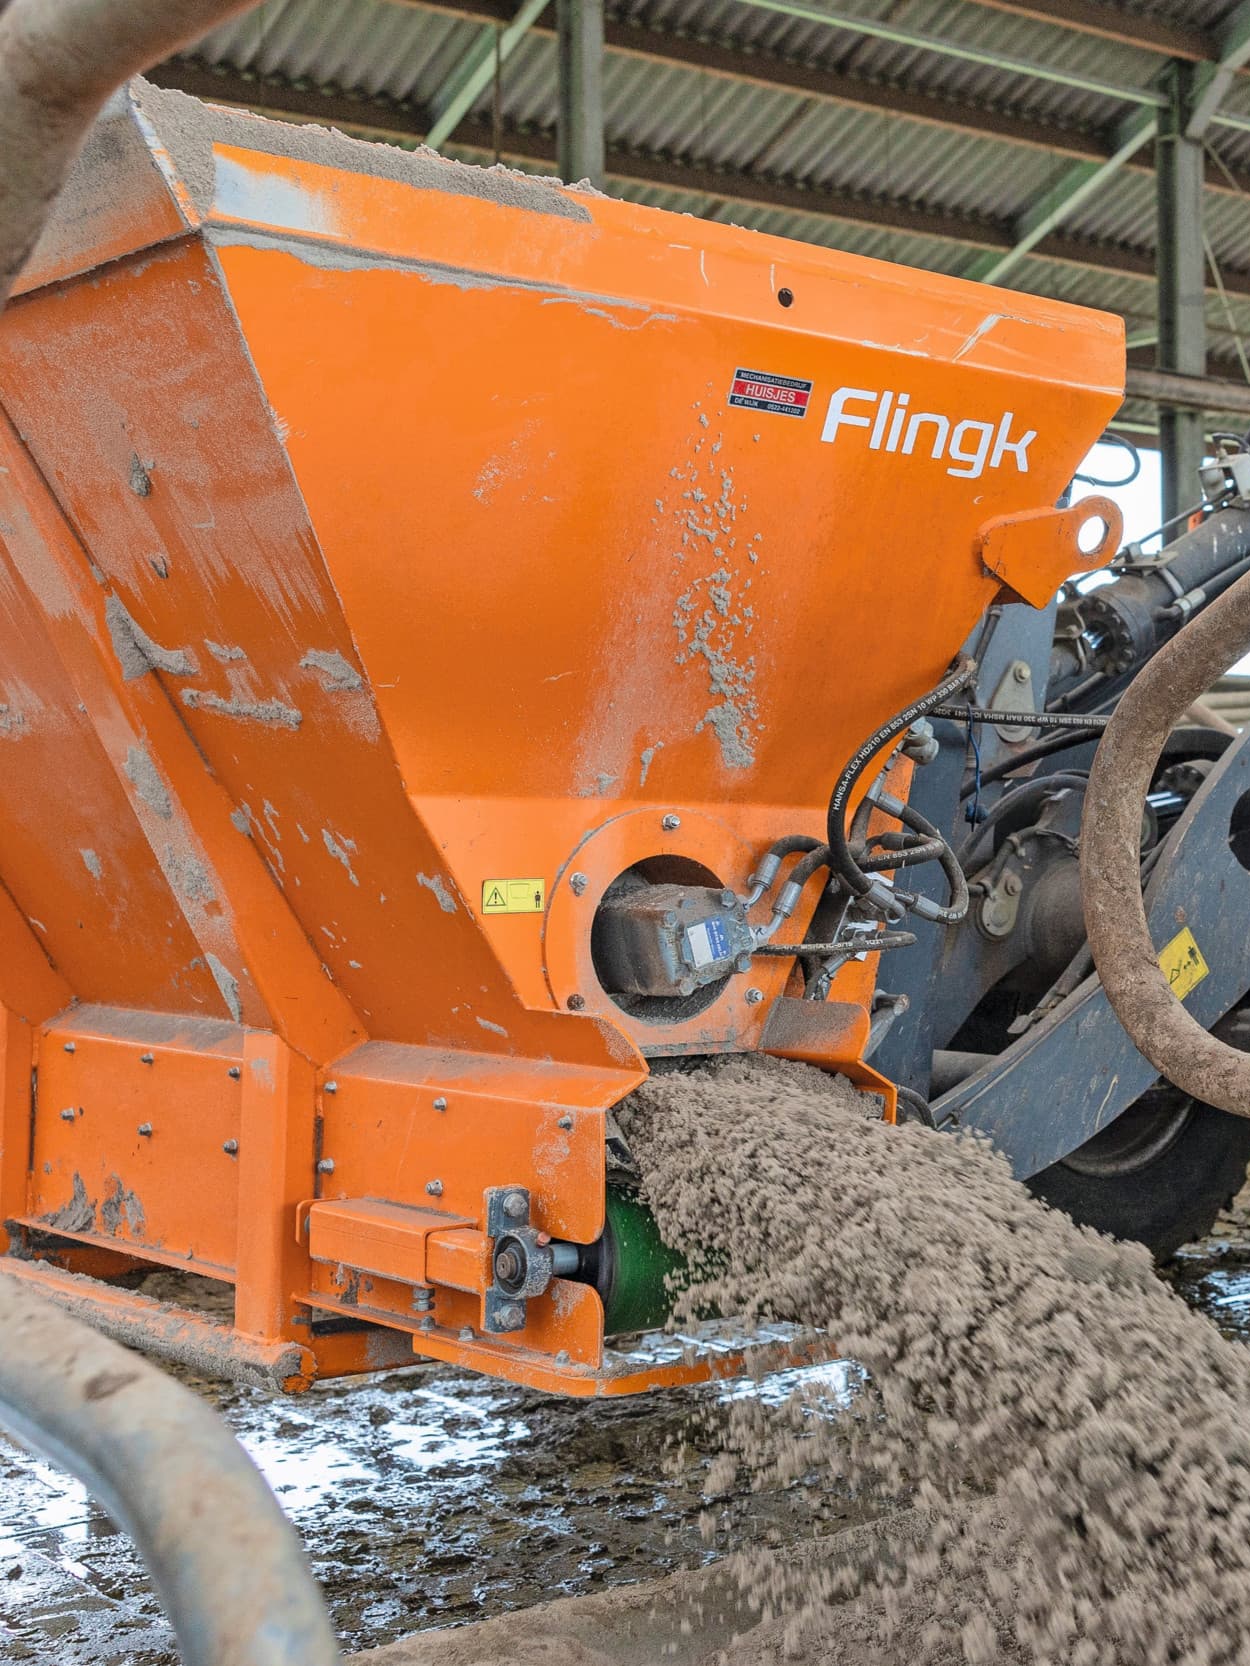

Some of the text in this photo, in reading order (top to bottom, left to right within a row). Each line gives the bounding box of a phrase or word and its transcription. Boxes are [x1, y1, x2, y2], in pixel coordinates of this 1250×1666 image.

[745, 383, 796, 402] HUISJES
[820, 386, 1038, 479] Flingk
[833, 758, 862, 811] HANSA-FLEX
[858, 737, 881, 759] HD210
[879, 725, 893, 740] EN
